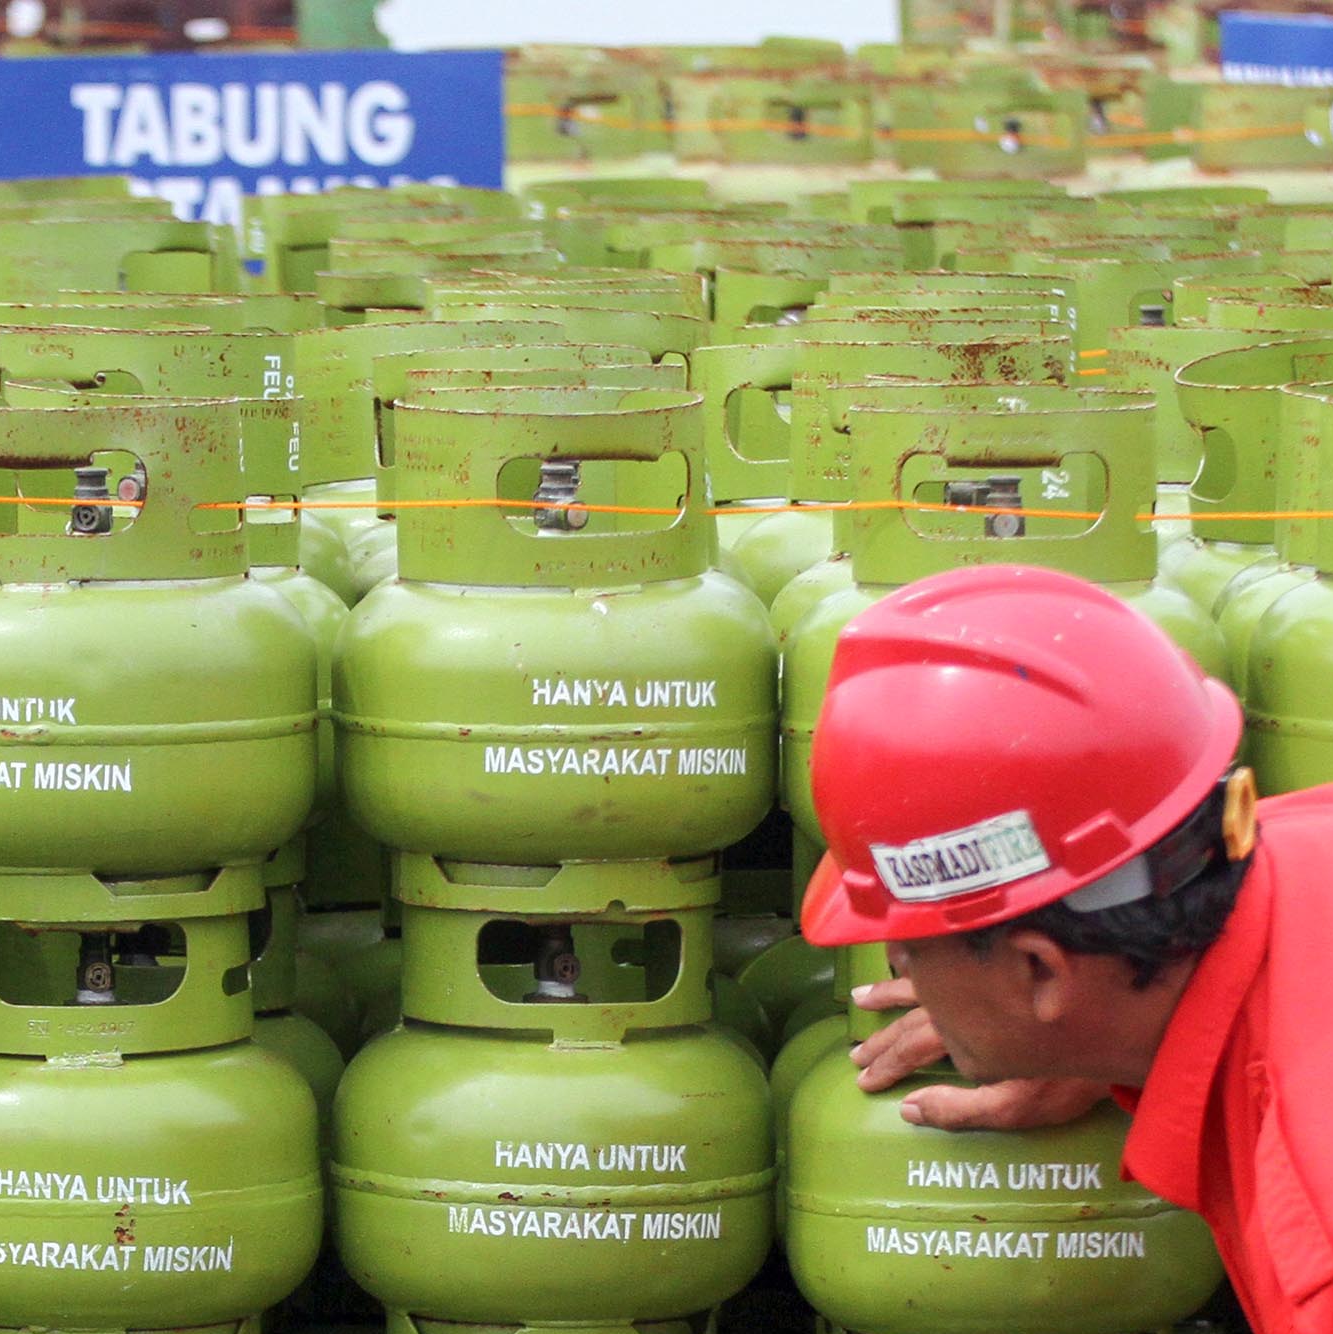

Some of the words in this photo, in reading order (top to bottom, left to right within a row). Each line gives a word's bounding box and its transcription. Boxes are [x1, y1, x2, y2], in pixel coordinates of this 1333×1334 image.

[69, 80, 416, 168] TABUNG
[532, 678, 628, 707] HANYA
[634, 680, 716, 708] UNTUK
[484, 746, 672, 775] MASYARAKAT
[677, 747, 746, 776] MISKIN
[34, 762, 132, 792] MISKIN
[495, 1140, 590, 1171] HANYA
[597, 1144, 686, 1172] UNTUK
[96, 1176, 191, 1205] UNTUK
[907, 1160, 1000, 1189] HANYA
[1007, 1163, 1101, 1191] UNTUK
[448, 1205, 637, 1240] MASYARAKAT
[642, 1212, 721, 1240] MISKIN
[143, 1240, 233, 1272] MISKIN
[866, 1226, 1049, 1258] MASYARAKAT
[1056, 1231, 1145, 1259] MISKIN
